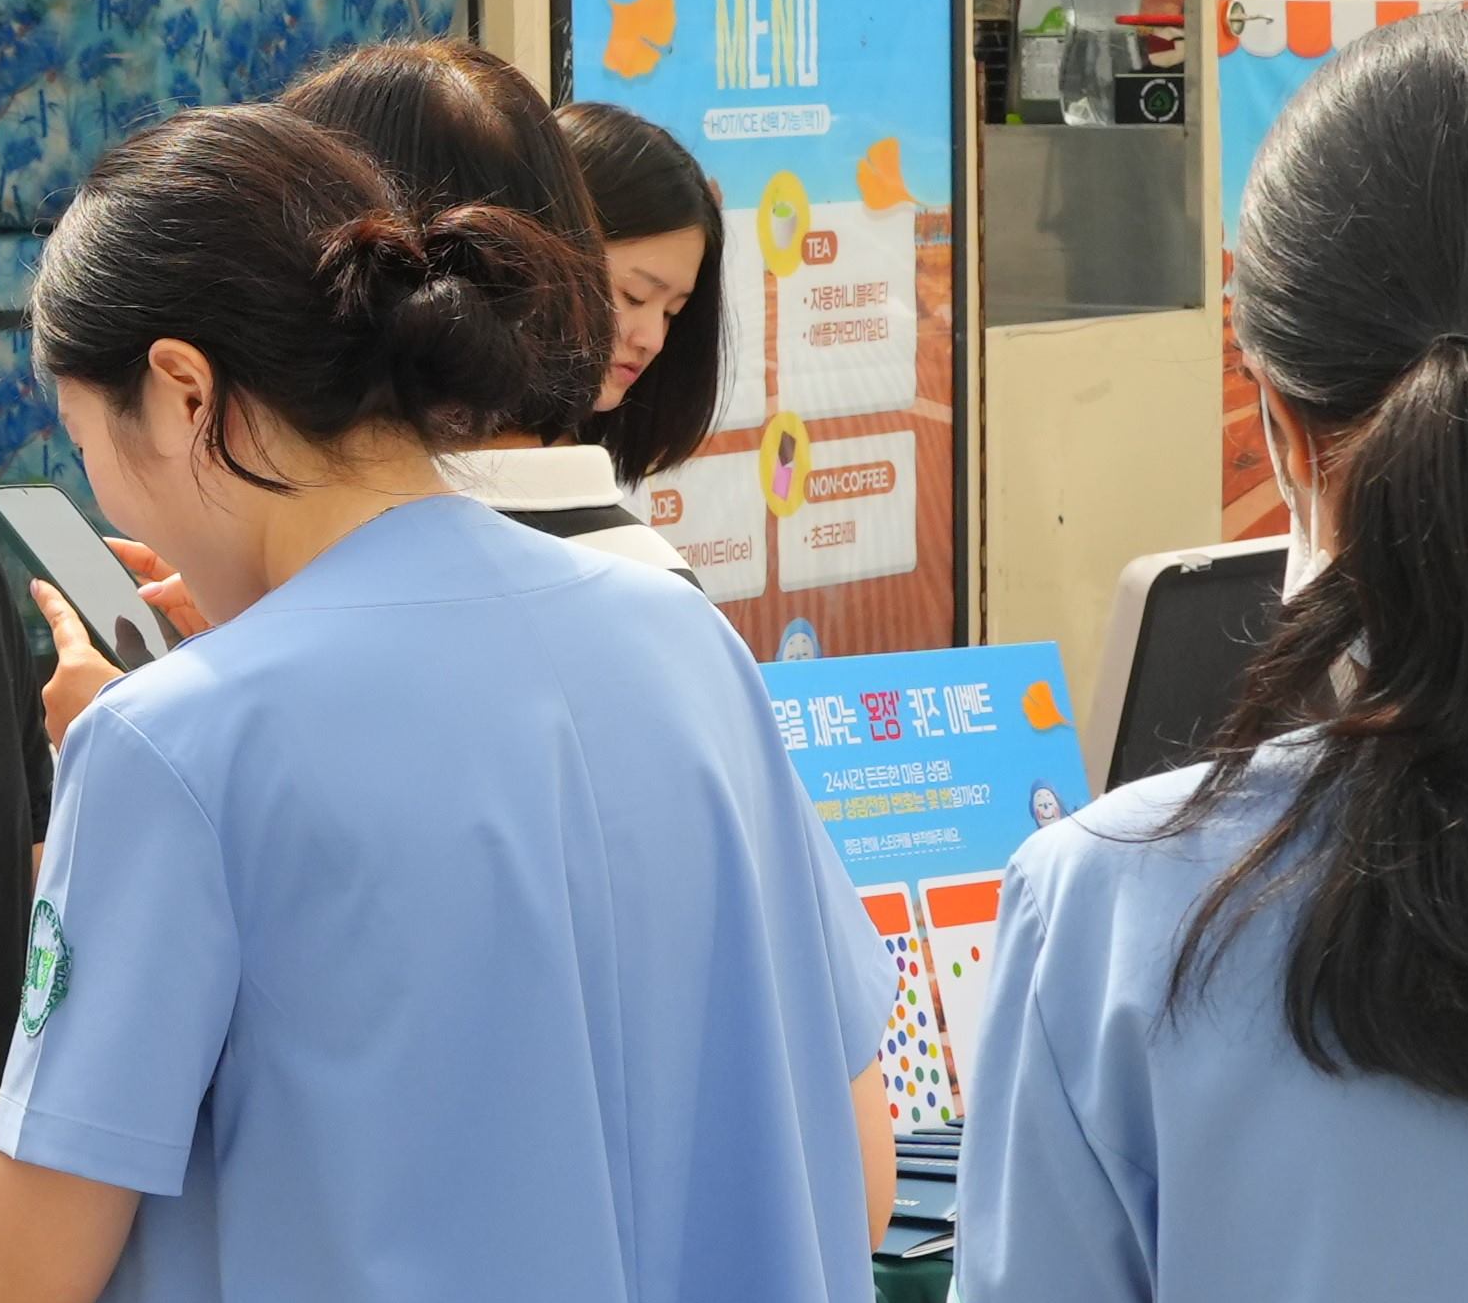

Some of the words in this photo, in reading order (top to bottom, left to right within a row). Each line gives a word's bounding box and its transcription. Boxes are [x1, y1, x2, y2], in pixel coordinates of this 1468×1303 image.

[805, 237, 832, 260] TEA
[809, 466, 889, 499] NON-COFFEE
[807, 694, 862, 746] 채우는
[906, 687, 946, 738] 퀴즈
[942, 682, 999, 734] 이벤트
[822, 766, 865, 794] 24시간
[866, 763, 901, 789] 든든한
[901, 761, 926, 786] 마음
